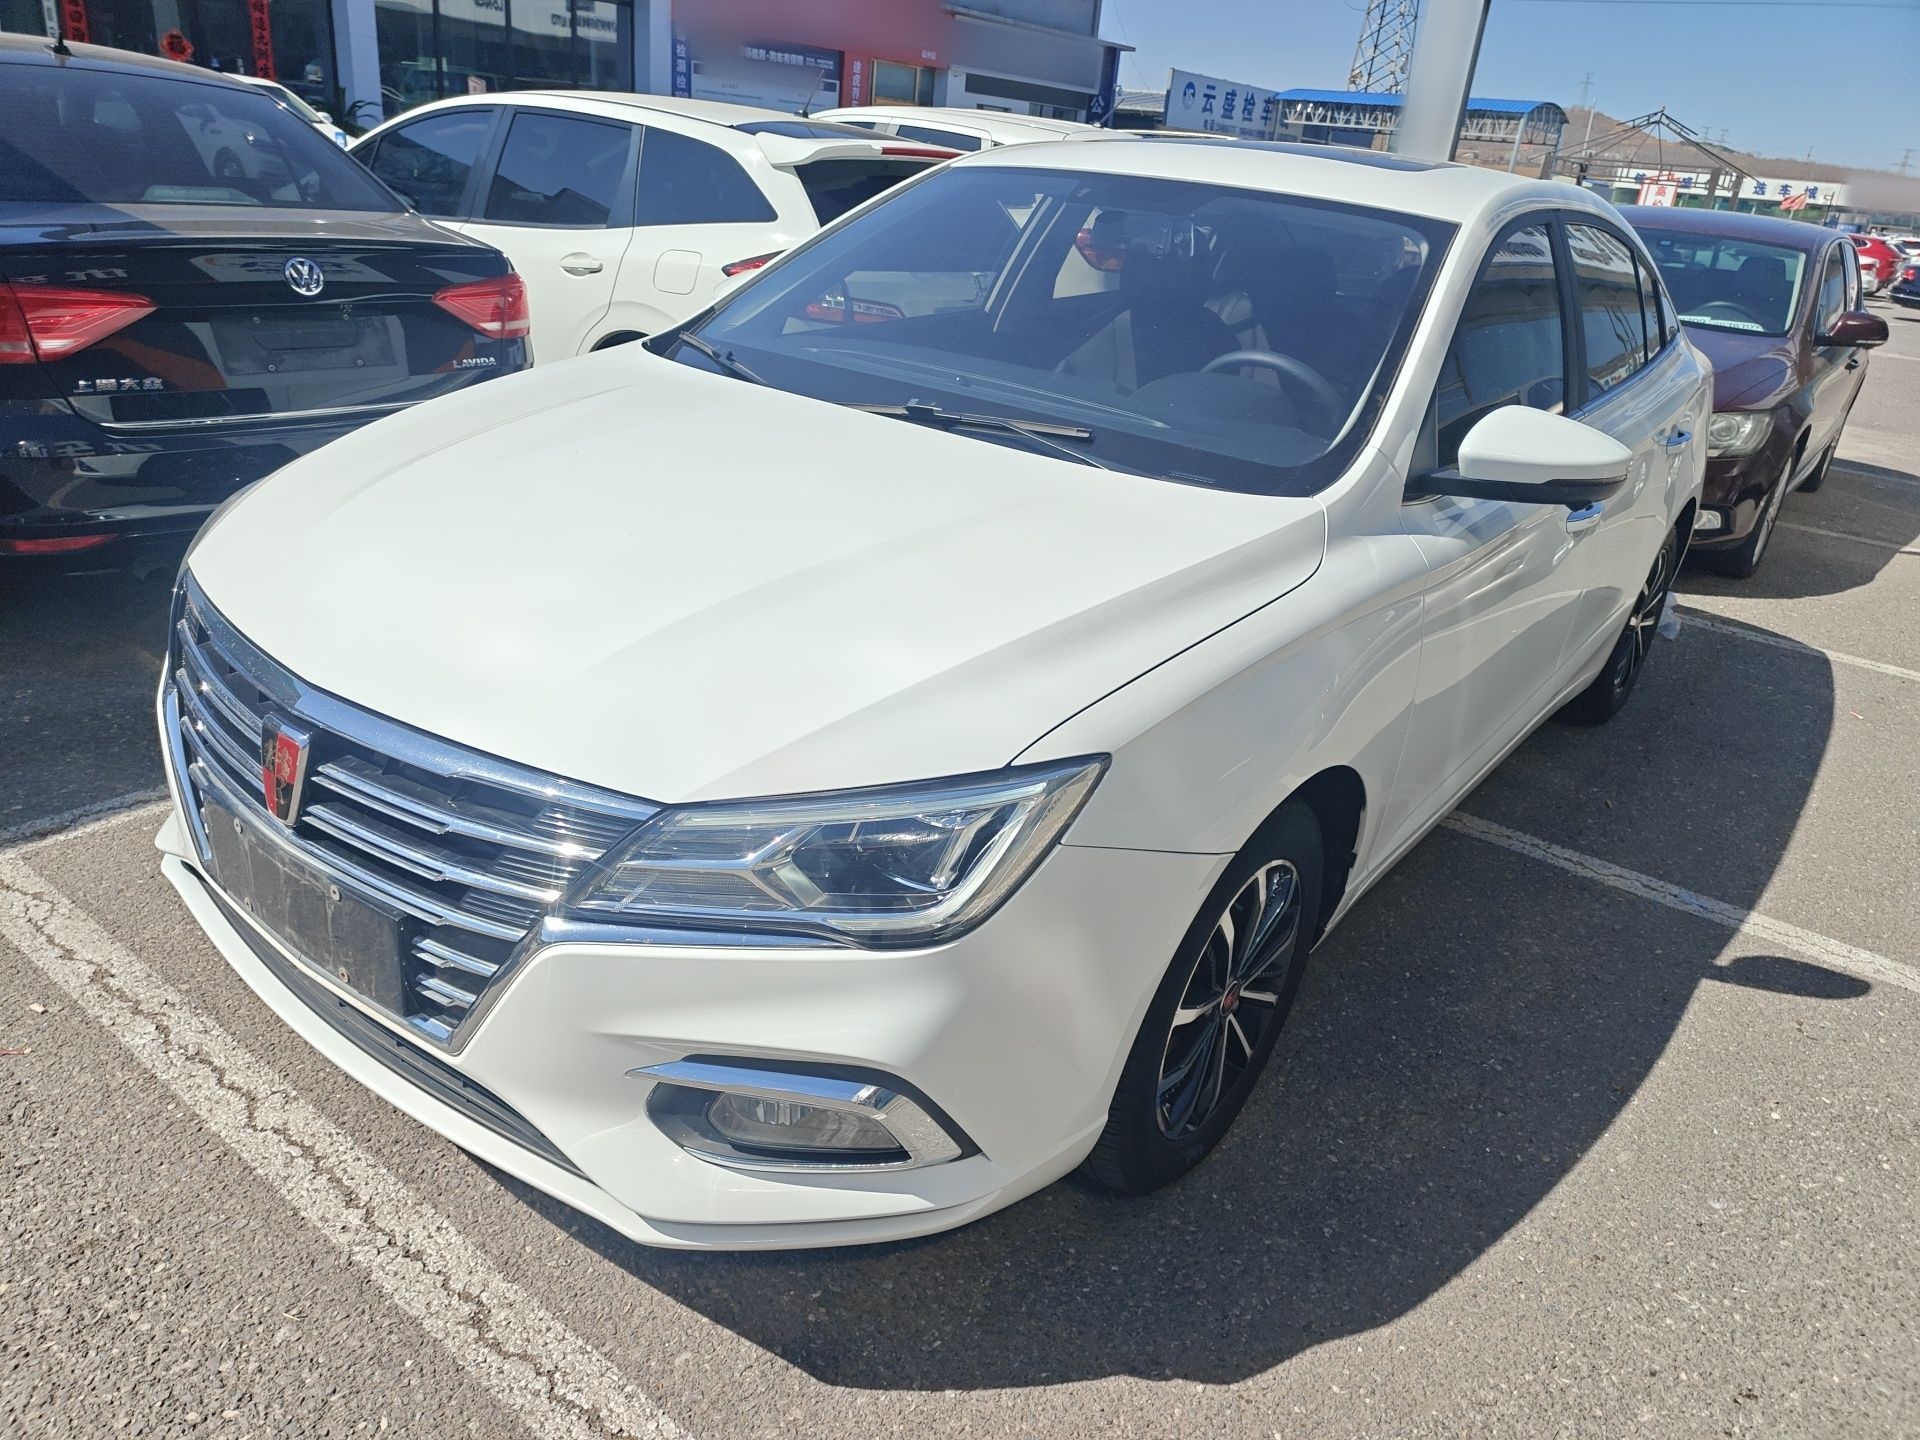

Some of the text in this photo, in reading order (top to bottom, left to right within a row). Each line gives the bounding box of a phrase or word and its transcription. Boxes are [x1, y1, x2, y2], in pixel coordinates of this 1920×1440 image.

[1201, 84, 1289, 129] 云盛检车
[452, 356, 497, 370] LAVIDA
